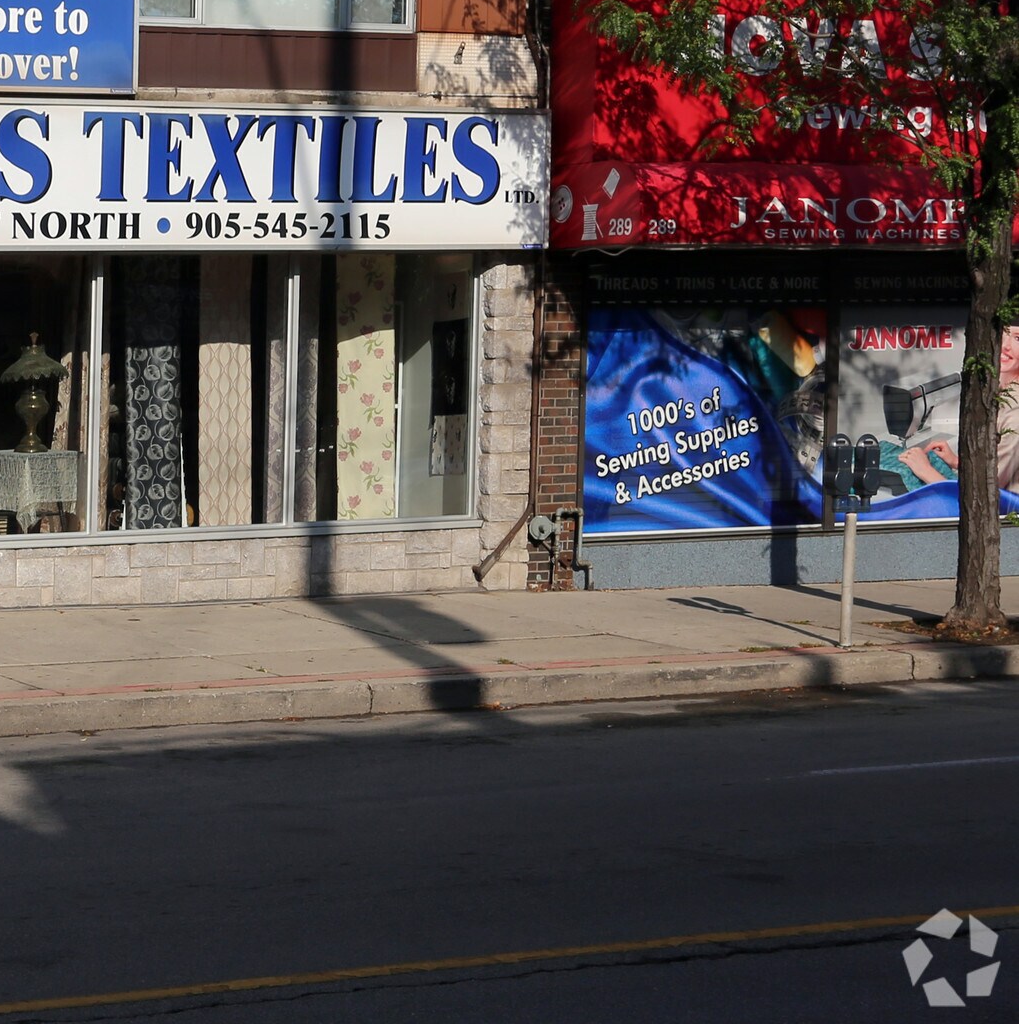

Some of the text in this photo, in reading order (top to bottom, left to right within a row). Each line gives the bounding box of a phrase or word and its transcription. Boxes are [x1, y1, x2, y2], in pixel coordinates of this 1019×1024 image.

[54, 1, 89, 35] to
[82, 109, 501, 206] TEXTILES
[504, 190, 539, 204] LTD.
[11, 211, 141, 239] NORTH
[185, 212, 391, 239] 905-545-2115
[608, 218, 632, 236] 289
[648, 219, 677, 235] 289
[765, 227, 960, 240] SEWING MACHINES
[596, 277, 819, 290] THREADS TRIMS LACE & MORE
[854, 276, 969, 288] SEWING MACHINES
[848, 326, 953, 350] JANOME
[627, 387, 720, 435] 1000's of
[595, 415, 760, 477] Sewing Supplies
[615, 450, 750, 505] & Accessories
